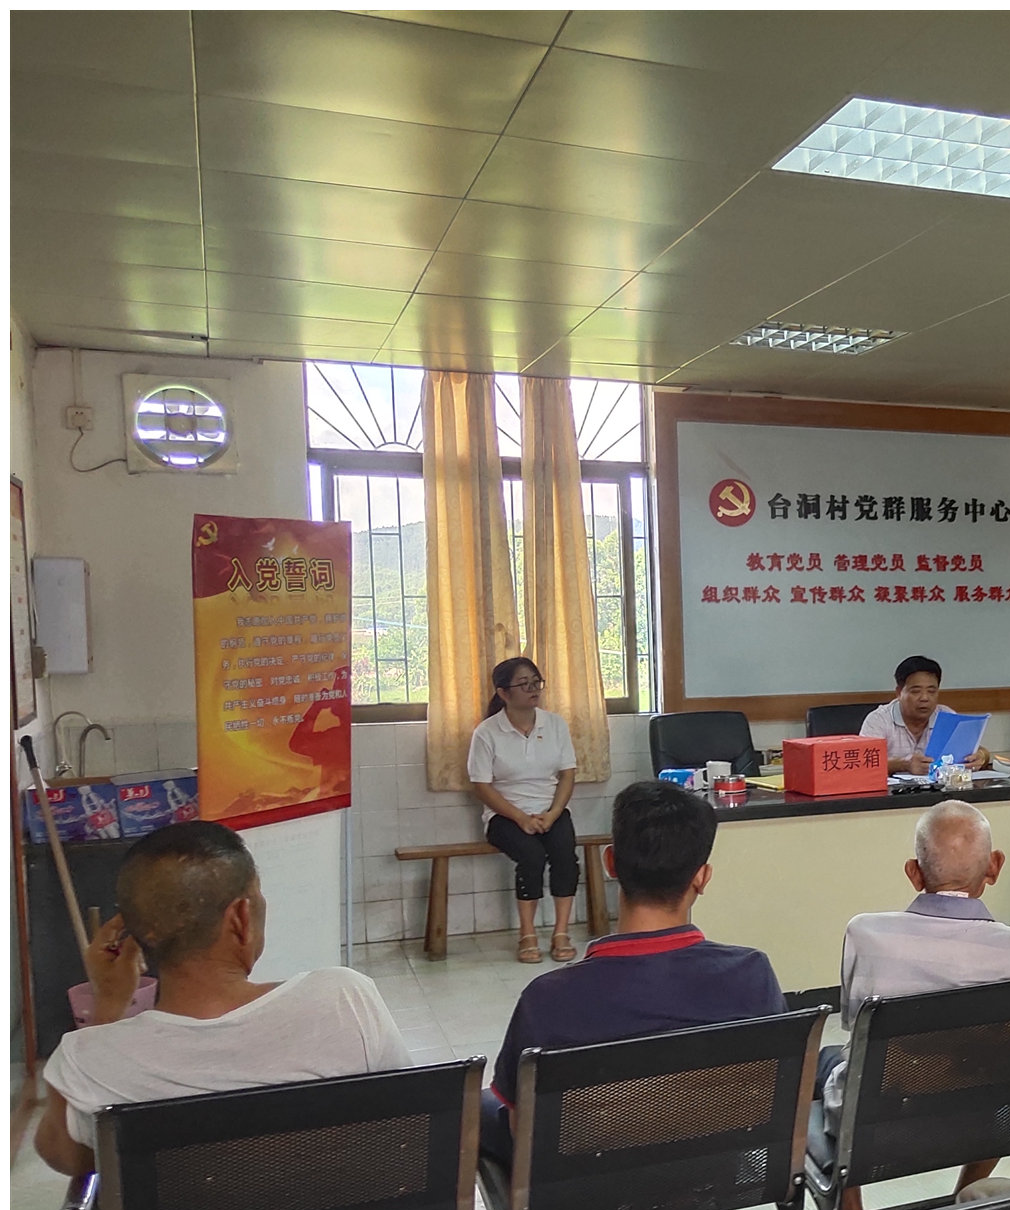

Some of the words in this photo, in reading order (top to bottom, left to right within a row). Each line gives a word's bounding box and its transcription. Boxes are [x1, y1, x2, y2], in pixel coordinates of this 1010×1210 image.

[746, 553, 823, 572] 教育党员
[833, 553, 906, 572] 管理党员
[915, 553, 984, 572] 监督党员
[227, 557, 336, 592] 入党誓词
[701, 584, 781, 604] 组织群众
[790, 584, 865, 604] 宣传群众
[874, 584, 946, 603] 凝聚群众
[822, 747, 881, 772] 投票箱
